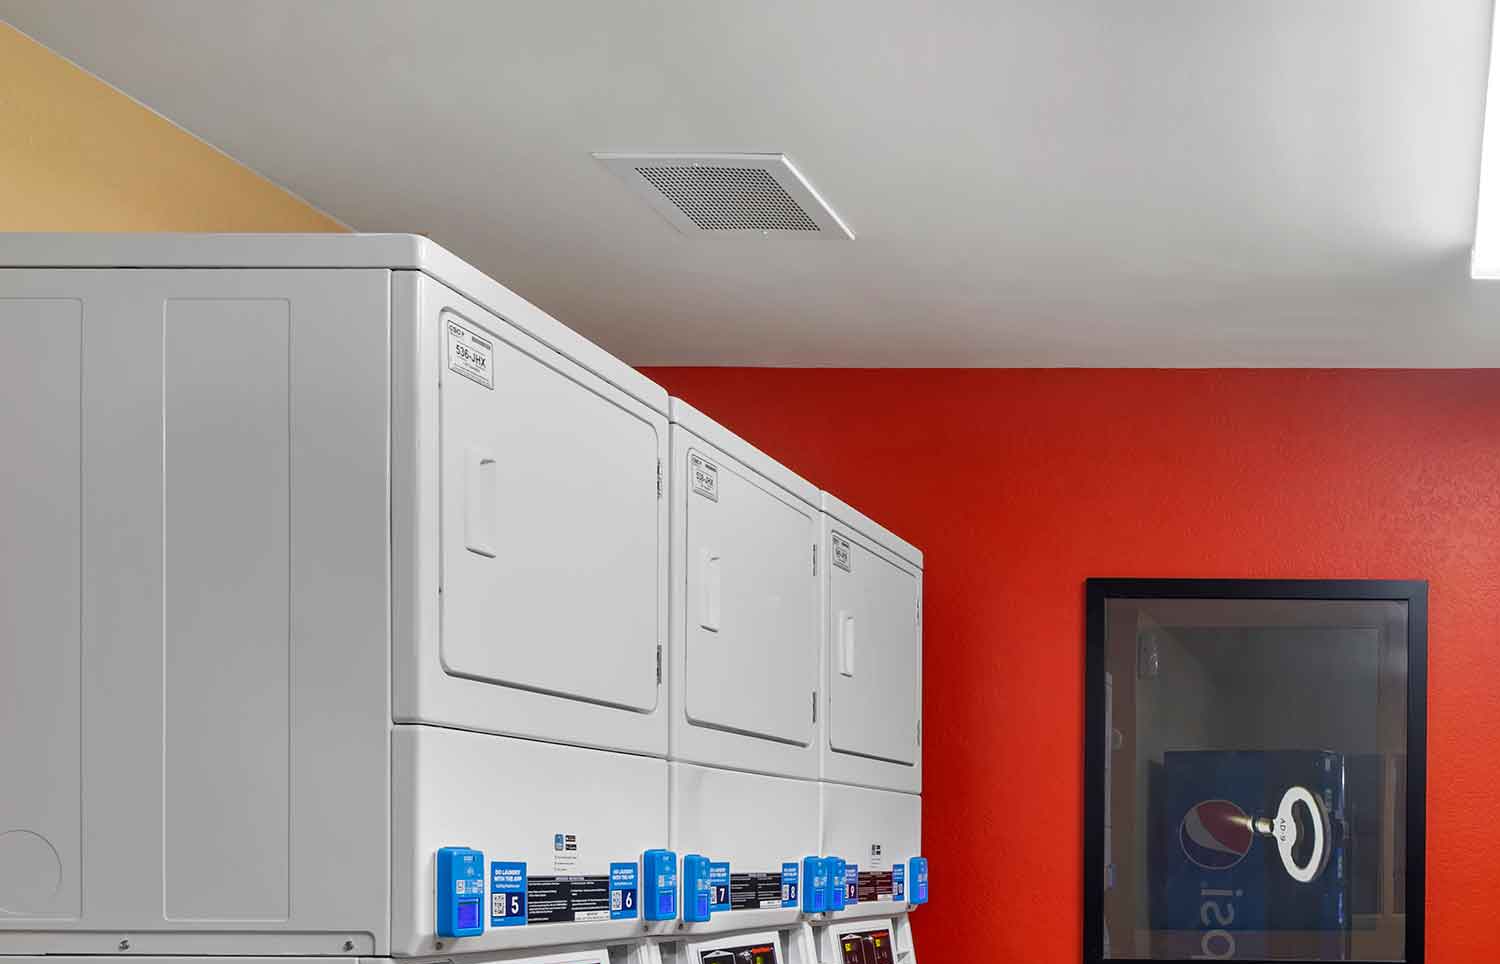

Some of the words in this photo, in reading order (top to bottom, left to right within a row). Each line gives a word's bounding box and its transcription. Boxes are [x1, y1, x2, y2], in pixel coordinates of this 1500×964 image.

[719, 887, 726, 902] 7
[850, 885, 855, 897] 9
[511, 896, 519, 914] 5
[625, 892, 632, 908] 6
